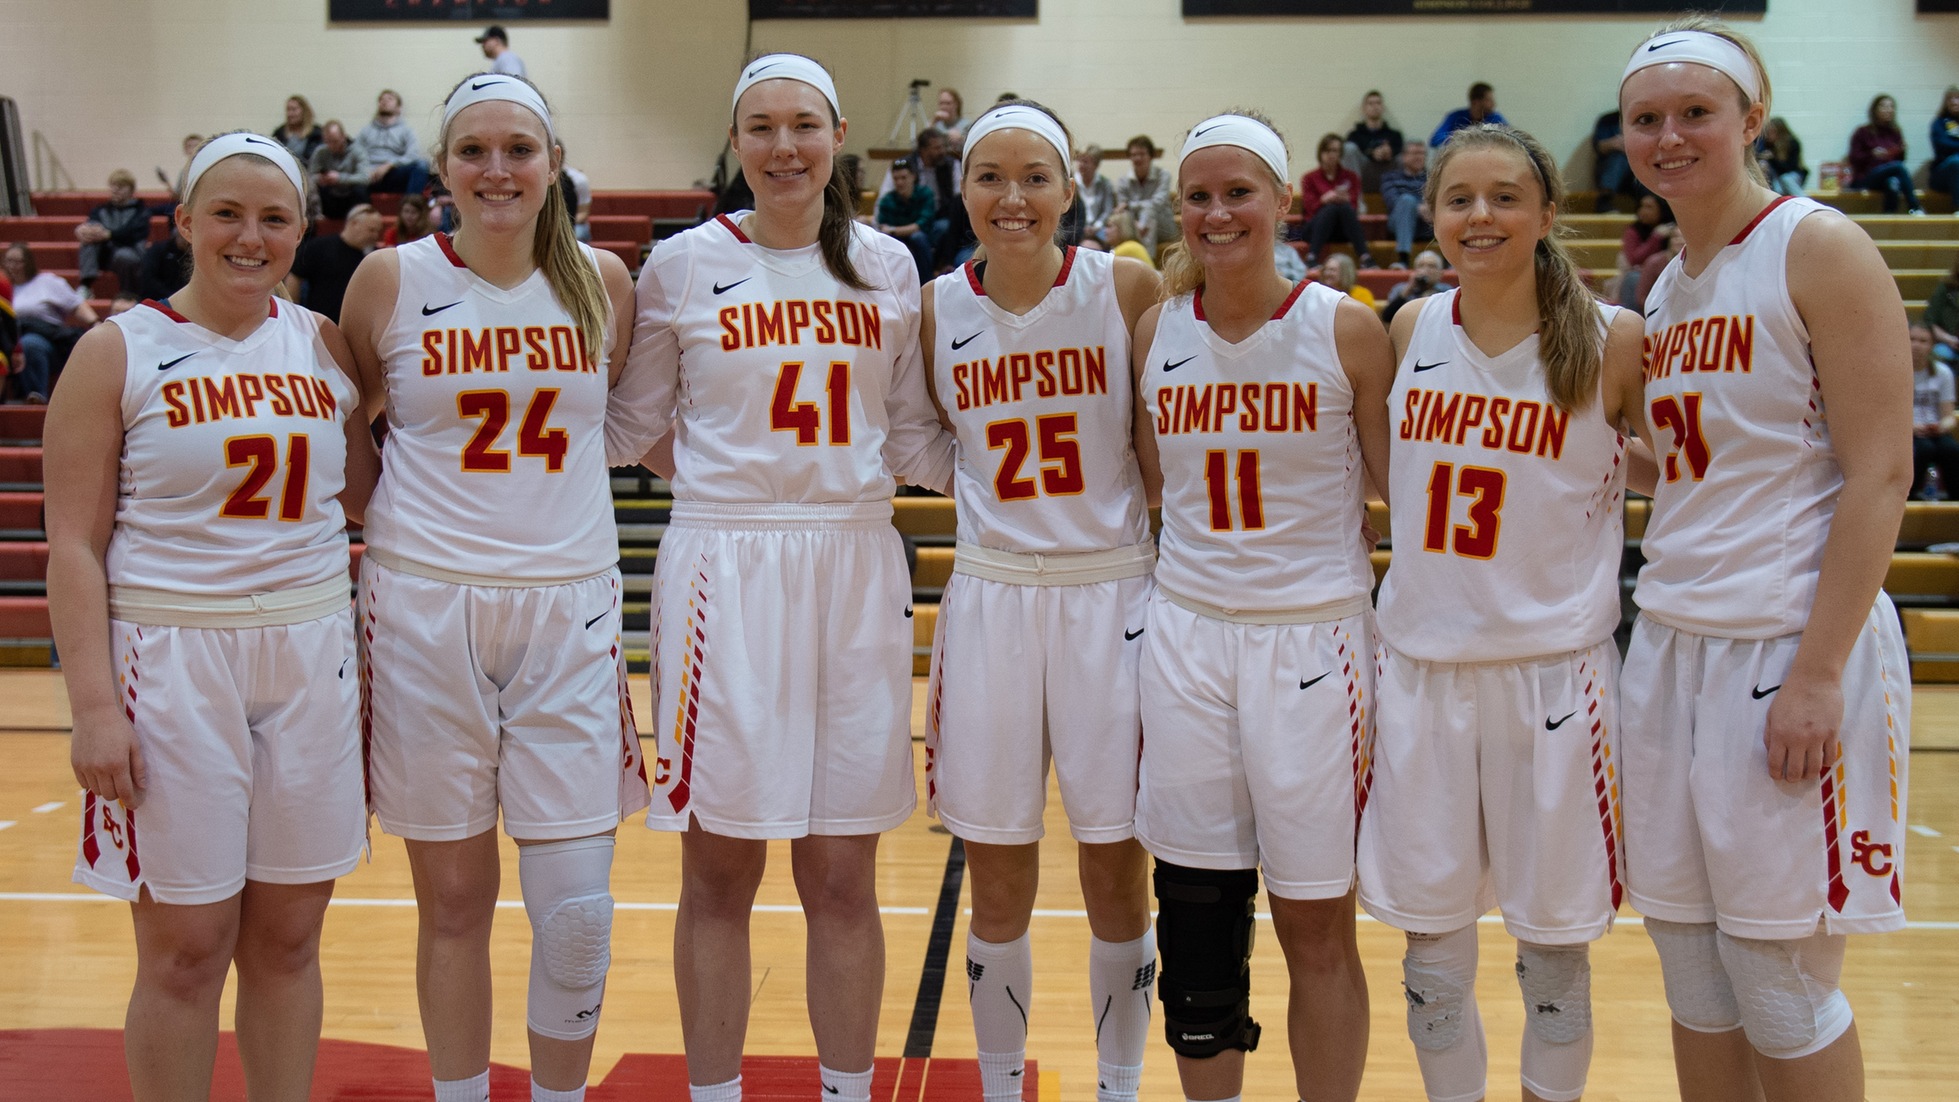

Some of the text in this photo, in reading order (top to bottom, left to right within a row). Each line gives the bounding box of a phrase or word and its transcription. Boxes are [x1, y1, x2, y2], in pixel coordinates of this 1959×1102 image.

[718, 299, 882, 352] SIMPSON
[1642, 314, 1755, 386] SIMPSON
[161, 373, 337, 429] SIMPSON
[769, 361, 851, 446] 41
[952, 345, 1108, 412] SIMPSON
[1157, 382, 1318, 436] SIMPSON
[456, 387, 569, 473] 24
[985, 411, 1085, 503] 25
[1400, 387, 1571, 461] SIMPSON
[218, 433, 310, 522] 21
[1204, 448, 1265, 532] 11
[1423, 460, 1507, 561] 13
[1850, 829, 1893, 878] SC
